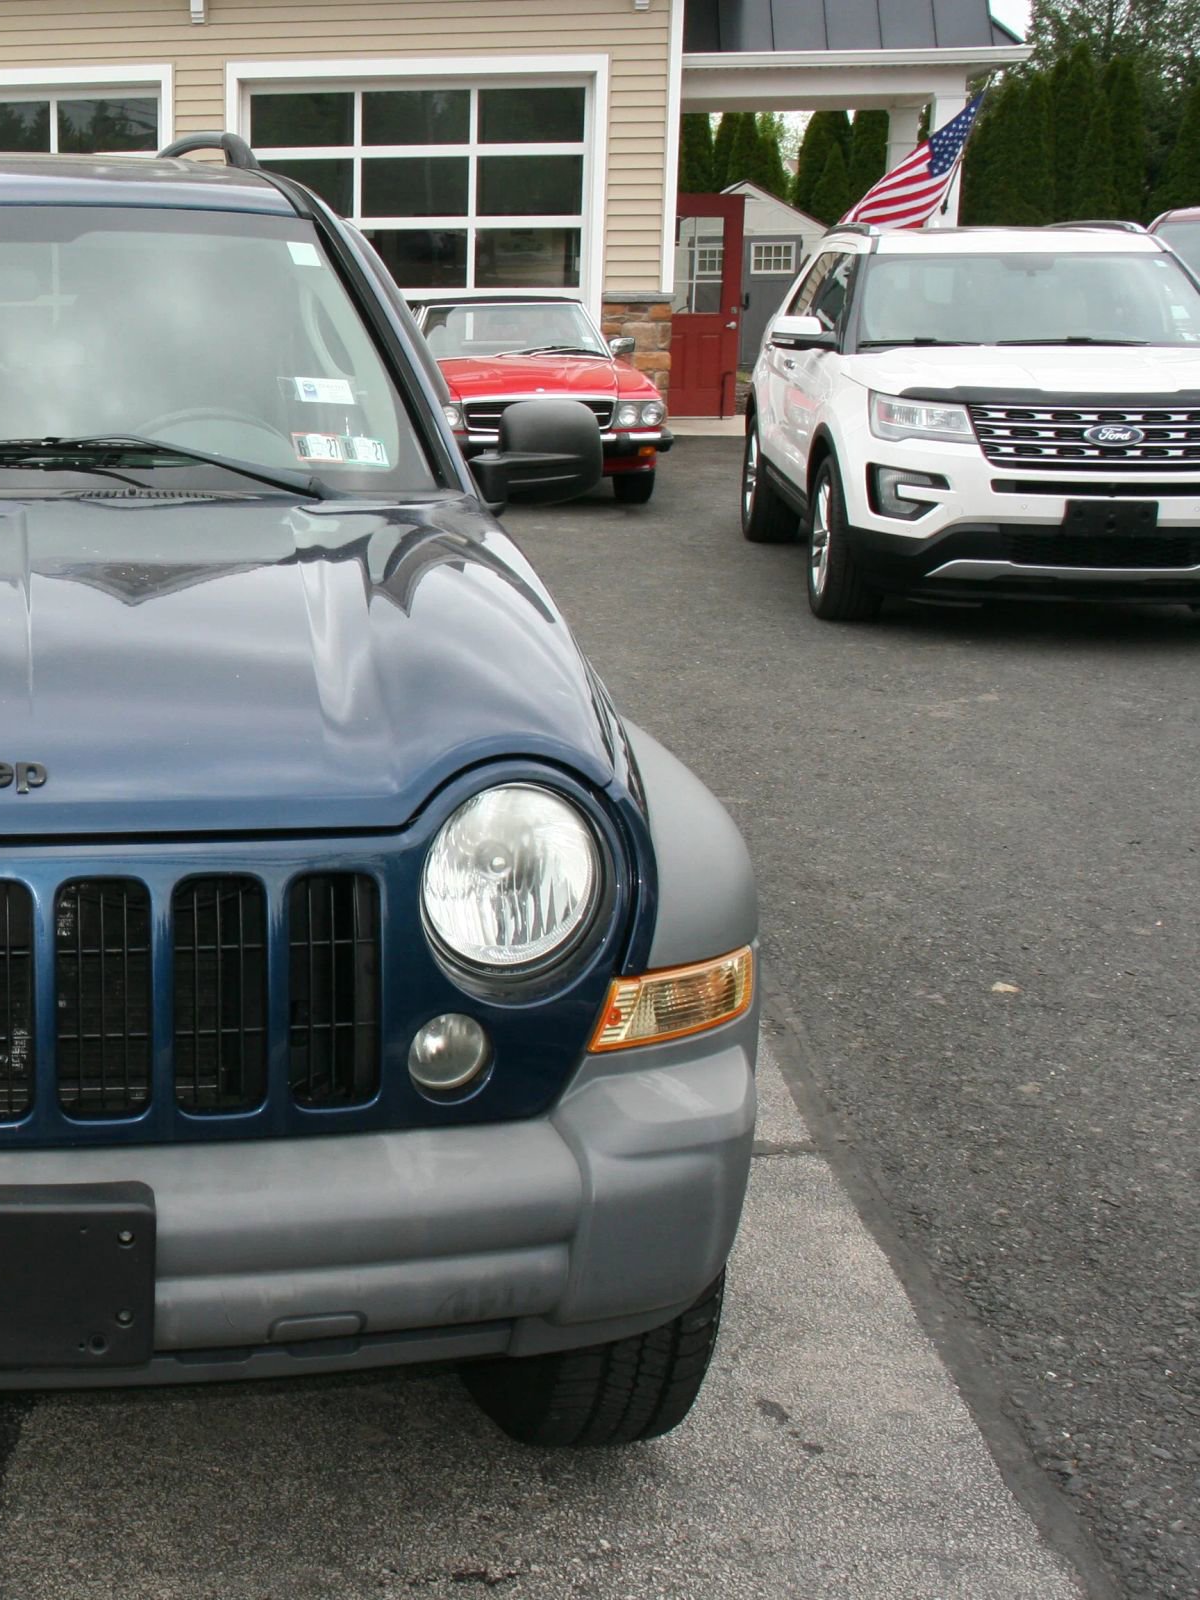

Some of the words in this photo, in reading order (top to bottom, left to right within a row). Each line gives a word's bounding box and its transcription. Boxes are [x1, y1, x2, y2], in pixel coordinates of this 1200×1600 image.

[1098, 427, 1133, 441] Ford
[326, 438, 340, 459] 27
[372, 441, 385, 463] 27
